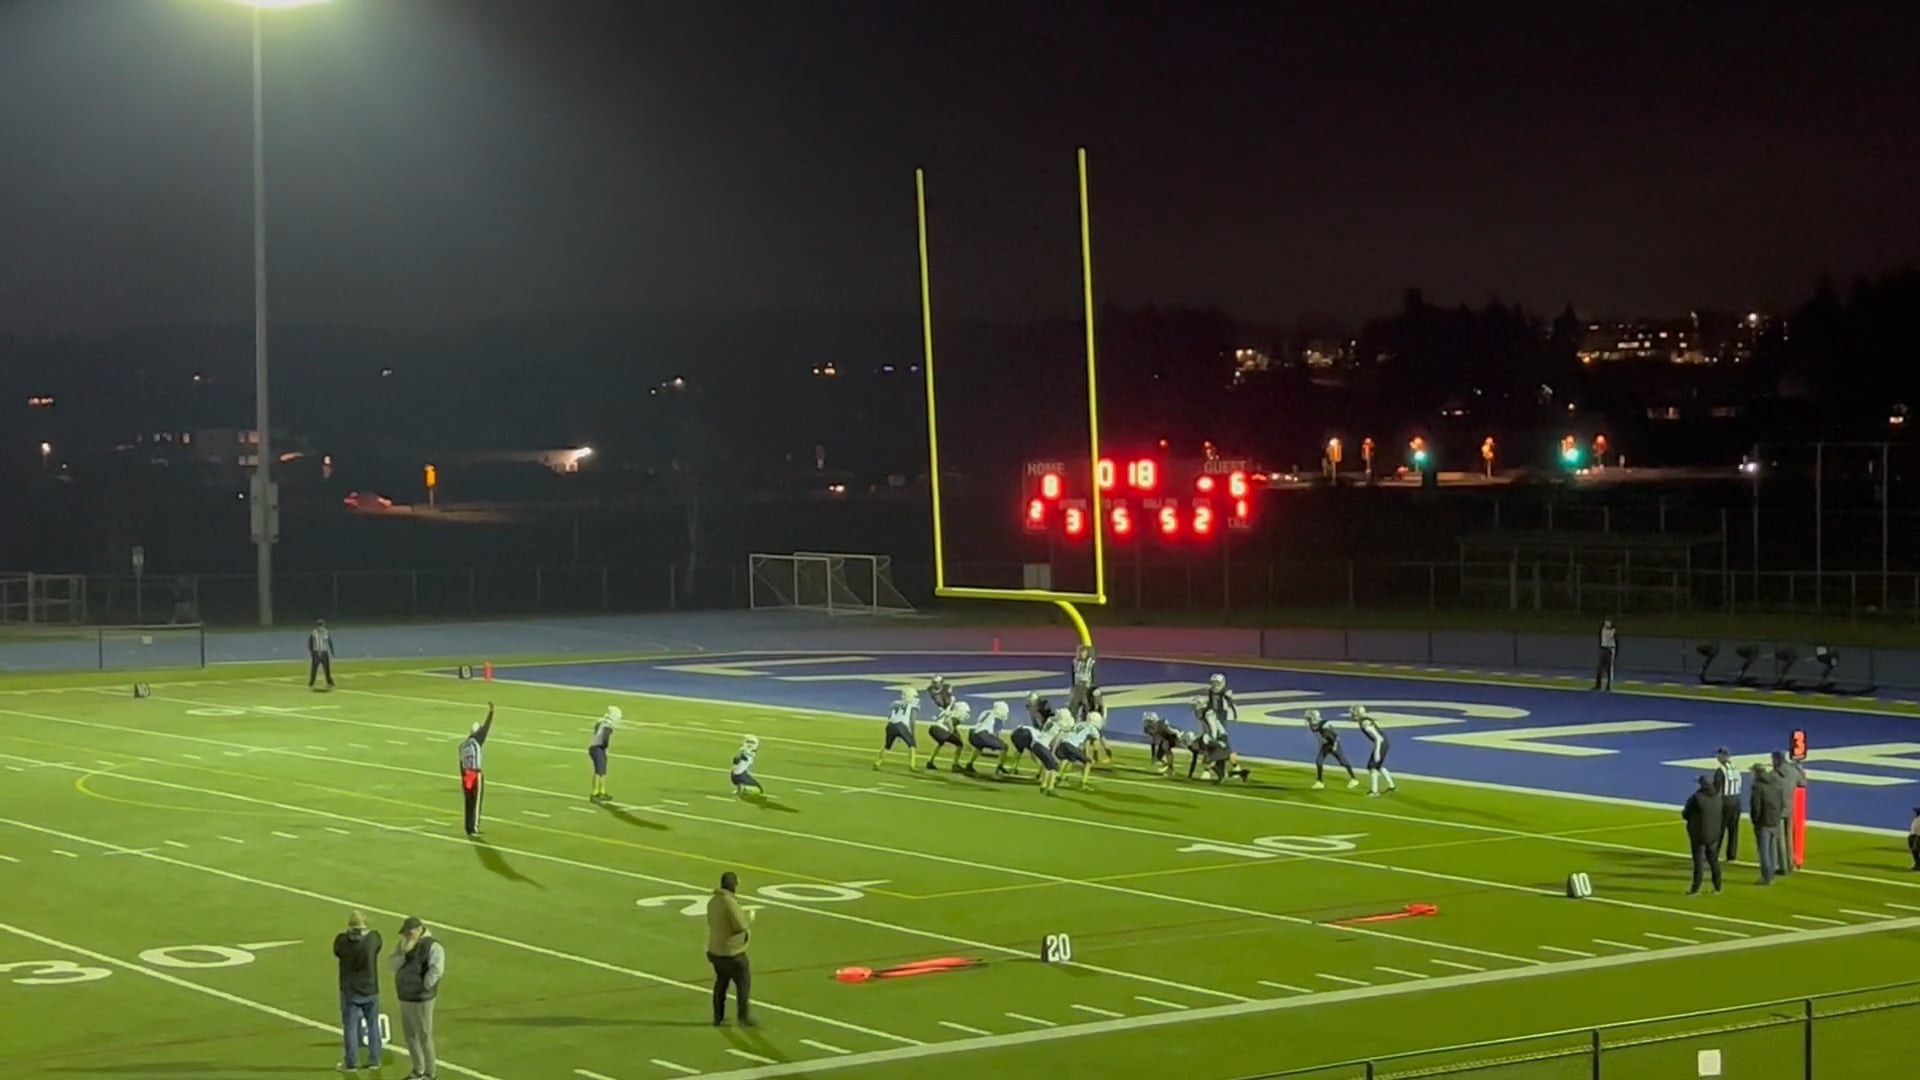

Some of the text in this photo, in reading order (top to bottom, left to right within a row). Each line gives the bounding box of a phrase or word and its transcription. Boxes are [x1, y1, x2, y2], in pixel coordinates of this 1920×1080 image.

[1028, 463, 1064, 476] HOME
[1204, 461, 1246, 474] GUEST
[1230, 472, 1246, 496] 6
[1066, 509, 1081, 533] 3
[1113, 508, 1128, 533] 5
[1160, 507, 1176, 533] 5
[1194, 507, 1209, 533] 2
[1793, 731, 1805, 756] 3
[1176, 835, 1357, 858] 10
[1571, 872, 1592, 897] 10
[1046, 932, 1071, 962] 20
